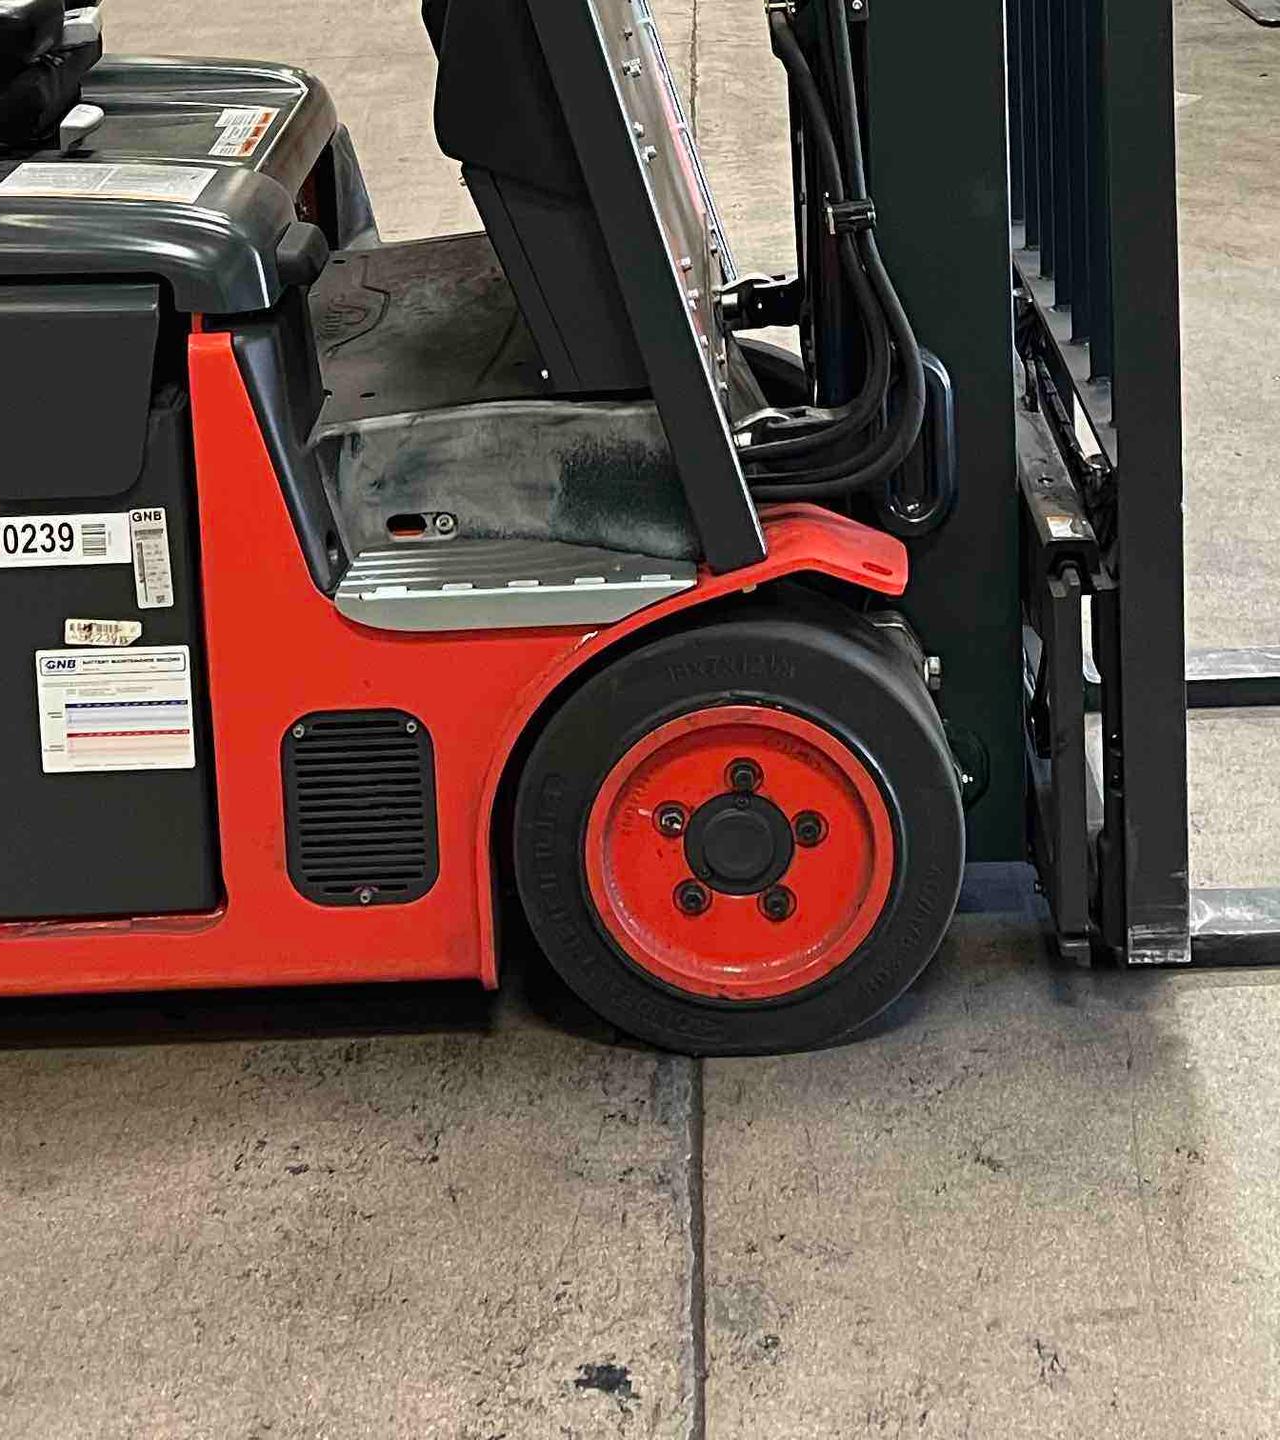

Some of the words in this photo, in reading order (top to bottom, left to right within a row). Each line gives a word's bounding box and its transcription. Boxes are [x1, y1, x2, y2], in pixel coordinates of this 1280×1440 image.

[132, 511, 162, 522] GNB
[3, 522, 75, 555] 0239
[45, 659, 76, 670] GNB
